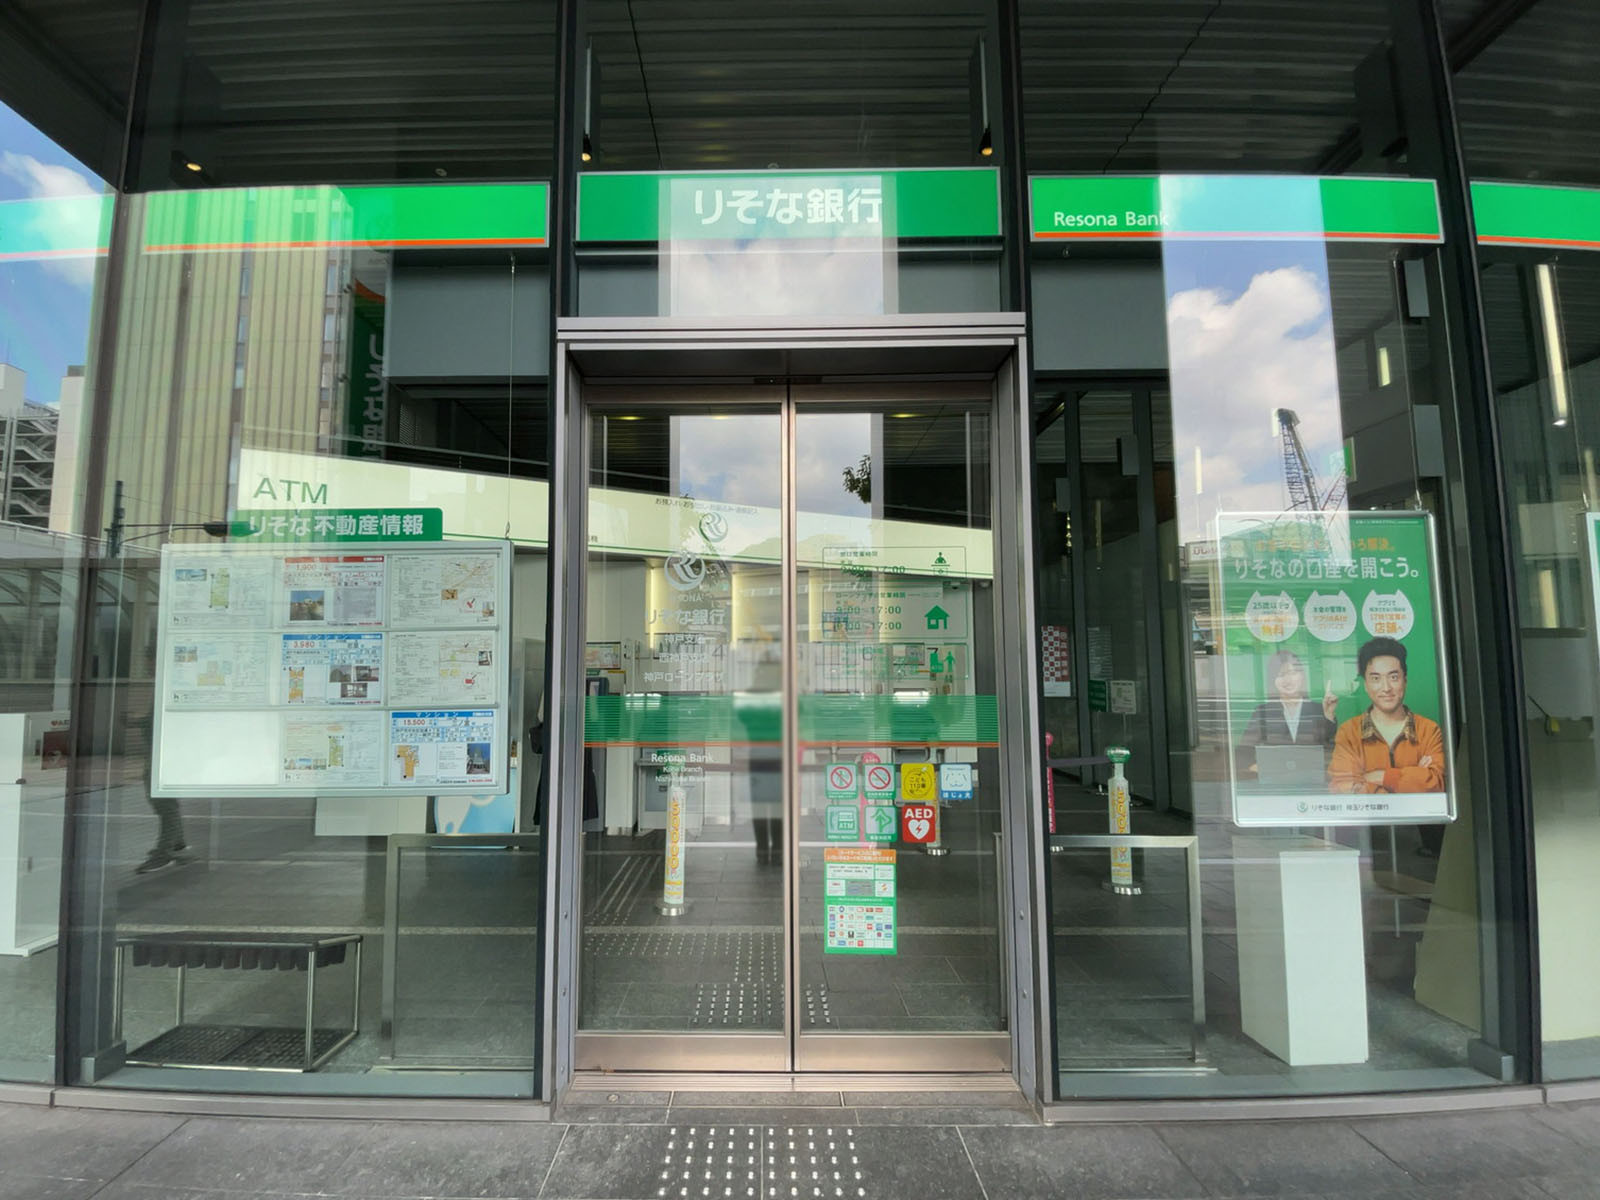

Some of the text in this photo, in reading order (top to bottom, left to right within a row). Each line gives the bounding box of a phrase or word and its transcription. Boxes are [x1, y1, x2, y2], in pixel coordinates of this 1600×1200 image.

[695, 188, 882, 225] りそな銀行
[1054, 211, 1168, 227] Resona Bank
[253, 477, 328, 505] ATM
[250, 514, 424, 537] りそな不動産情報
[1234, 556, 1419, 580] りそなの口座を開こう。
[651, 753, 714, 763] Resona Bank
[904, 808, 933, 819] AED
